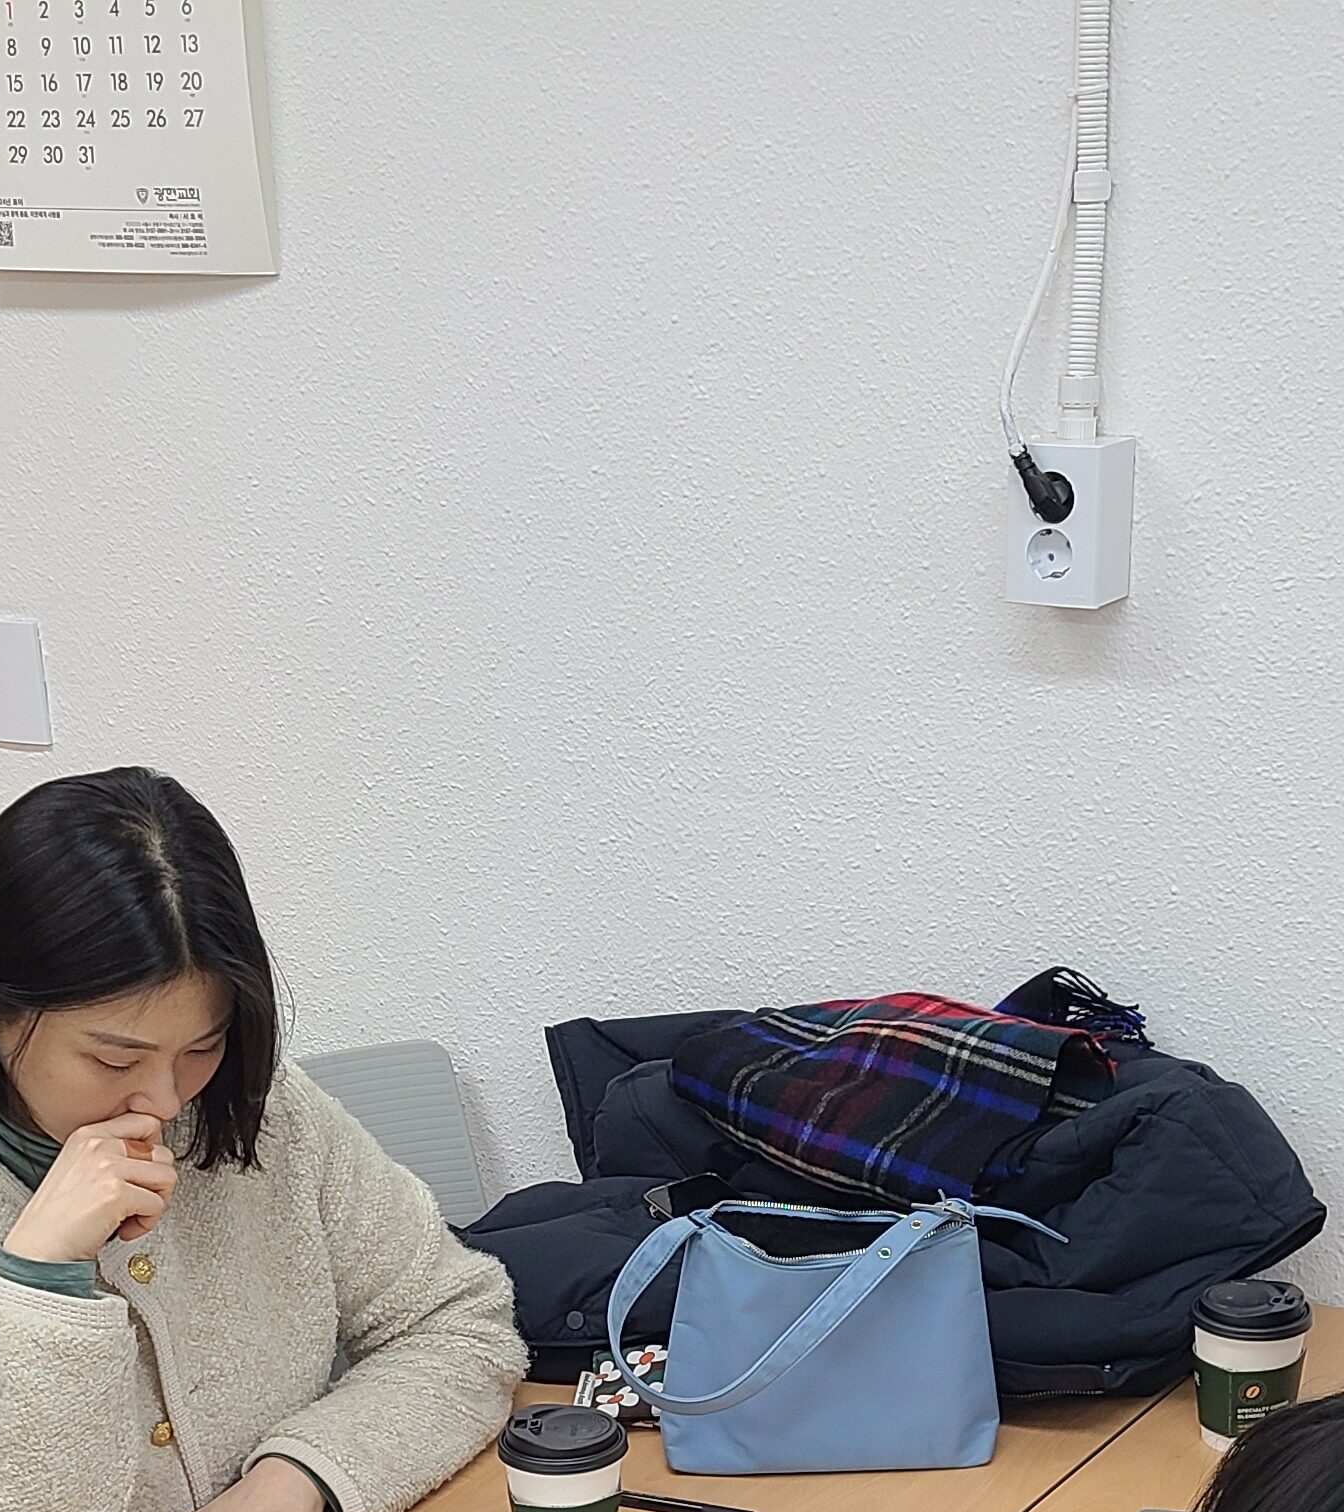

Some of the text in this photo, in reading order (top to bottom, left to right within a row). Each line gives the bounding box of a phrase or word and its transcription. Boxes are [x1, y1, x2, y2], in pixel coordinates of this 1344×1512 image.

[6, 0, 191, 20] 1 2 3 4 5 6
[8, 39, 16, 56] 8
[41, 38, 50, 56] 9
[73, 37, 91, 55] 10
[109, 36, 123, 54] 11
[144, 35, 161, 54] 12
[181, 35, 198, 53] 13
[6, 75, 23, 92] 15
[41, 74, 58, 91] 16
[76, 74, 91, 91] 17
[110, 73, 128, 91] 18
[146, 72, 164, 90] 19
[180, 72, 202, 90] 20
[6, 111, 25, 128] 22
[42, 111, 60, 127] 23
[76, 110, 95, 127] 24
[111, 110, 130, 127] 25
[147, 109, 167, 127] 26
[184, 109, 204, 127] 27
[9, 146, 27, 164] 29
[43, 146, 63, 164] 30
[79, 146, 95, 164] 31
